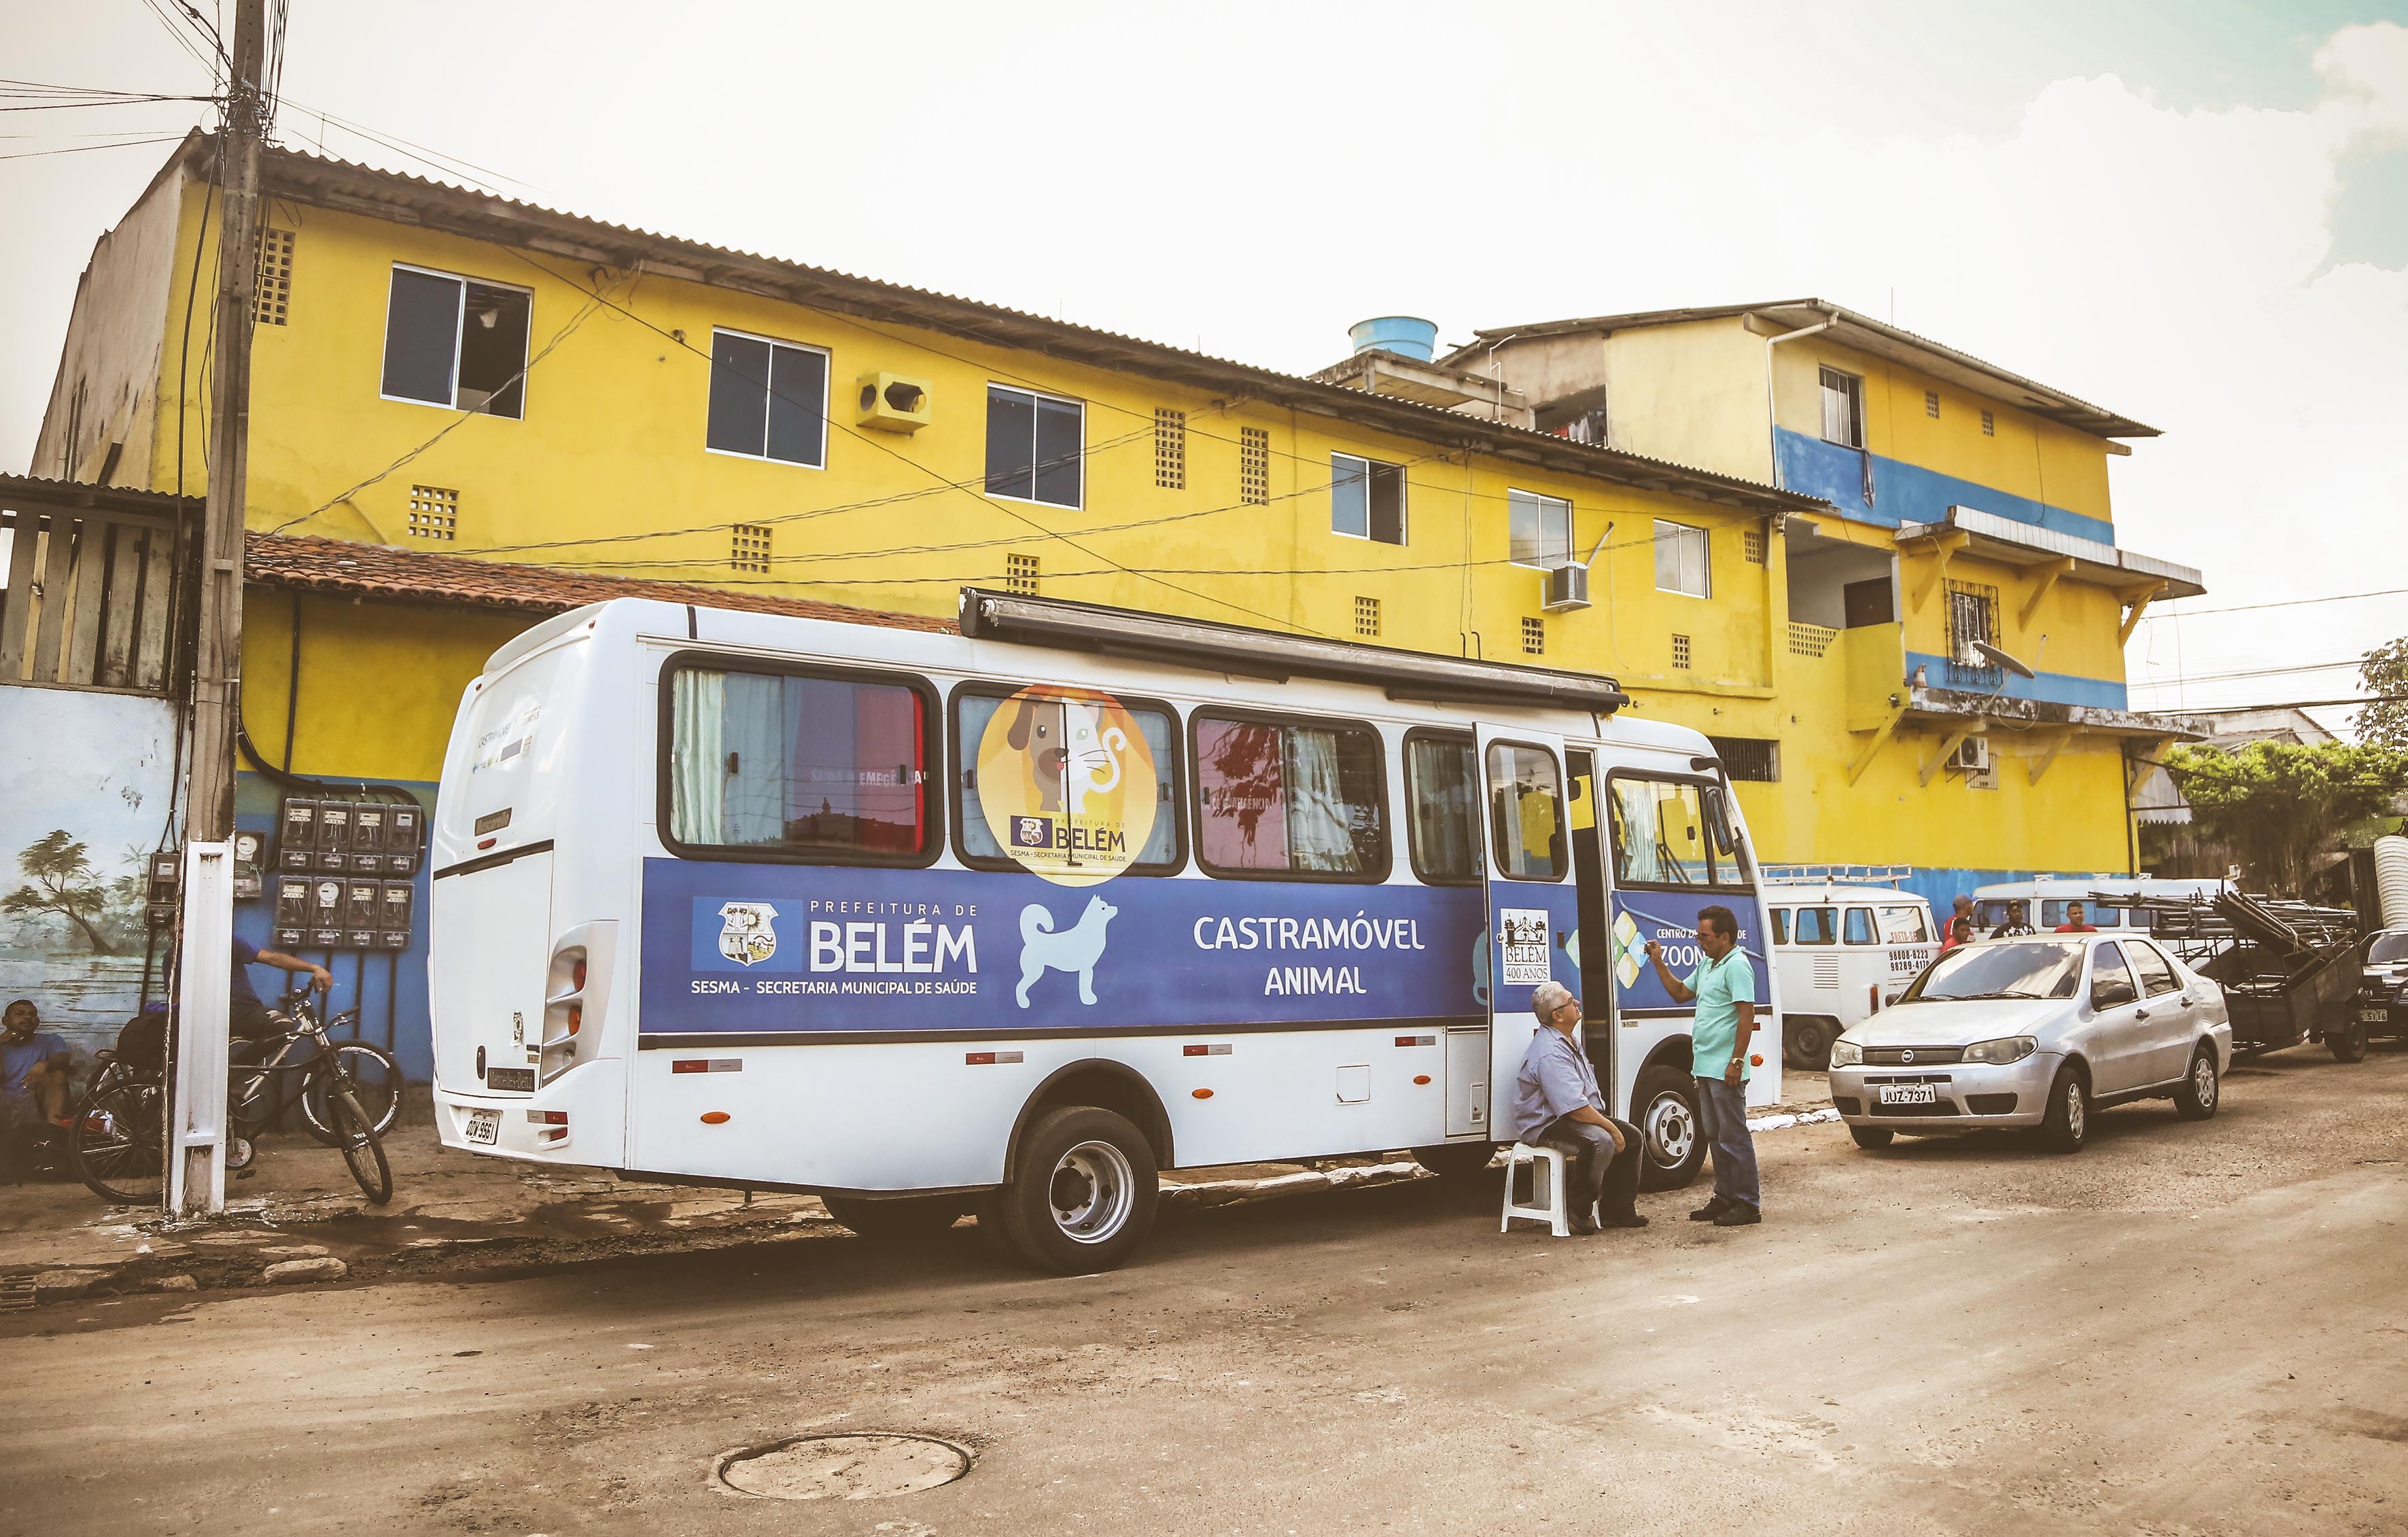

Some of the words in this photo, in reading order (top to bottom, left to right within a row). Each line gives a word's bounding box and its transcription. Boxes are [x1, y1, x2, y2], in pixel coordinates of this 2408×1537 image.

[1056, 828, 1126, 852] BELÉM
[810, 900, 941, 916] PREFEITURA
[955, 904, 977, 916] DE
[1193, 909, 1425, 951] CASTRAMÓVEL
[1656, 928, 1686, 938] CENTRO
[1688, 929, 1698, 938] D
[810, 918, 977, 972] BELÉM
[1505, 945, 1546, 962] BELÉM
[1660, 945, 1707, 966] ZOON
[1889, 950, 1928, 961] 98808-8223
[1265, 967, 1366, 995] ANIMAL
[1506, 968, 1521, 978] 400
[1523, 968, 1548, 979] ANOS
[691, 980, 740, 993] SESMA
[756, 980, 838, 994] SECRETARIA
[841, 981, 912, 994] MUNICIPAL
[915, 982, 933, 994] DE
[936, 978, 977, 994] SAÚDE
[1884, 1091, 1932, 1102] JUZ-7371
